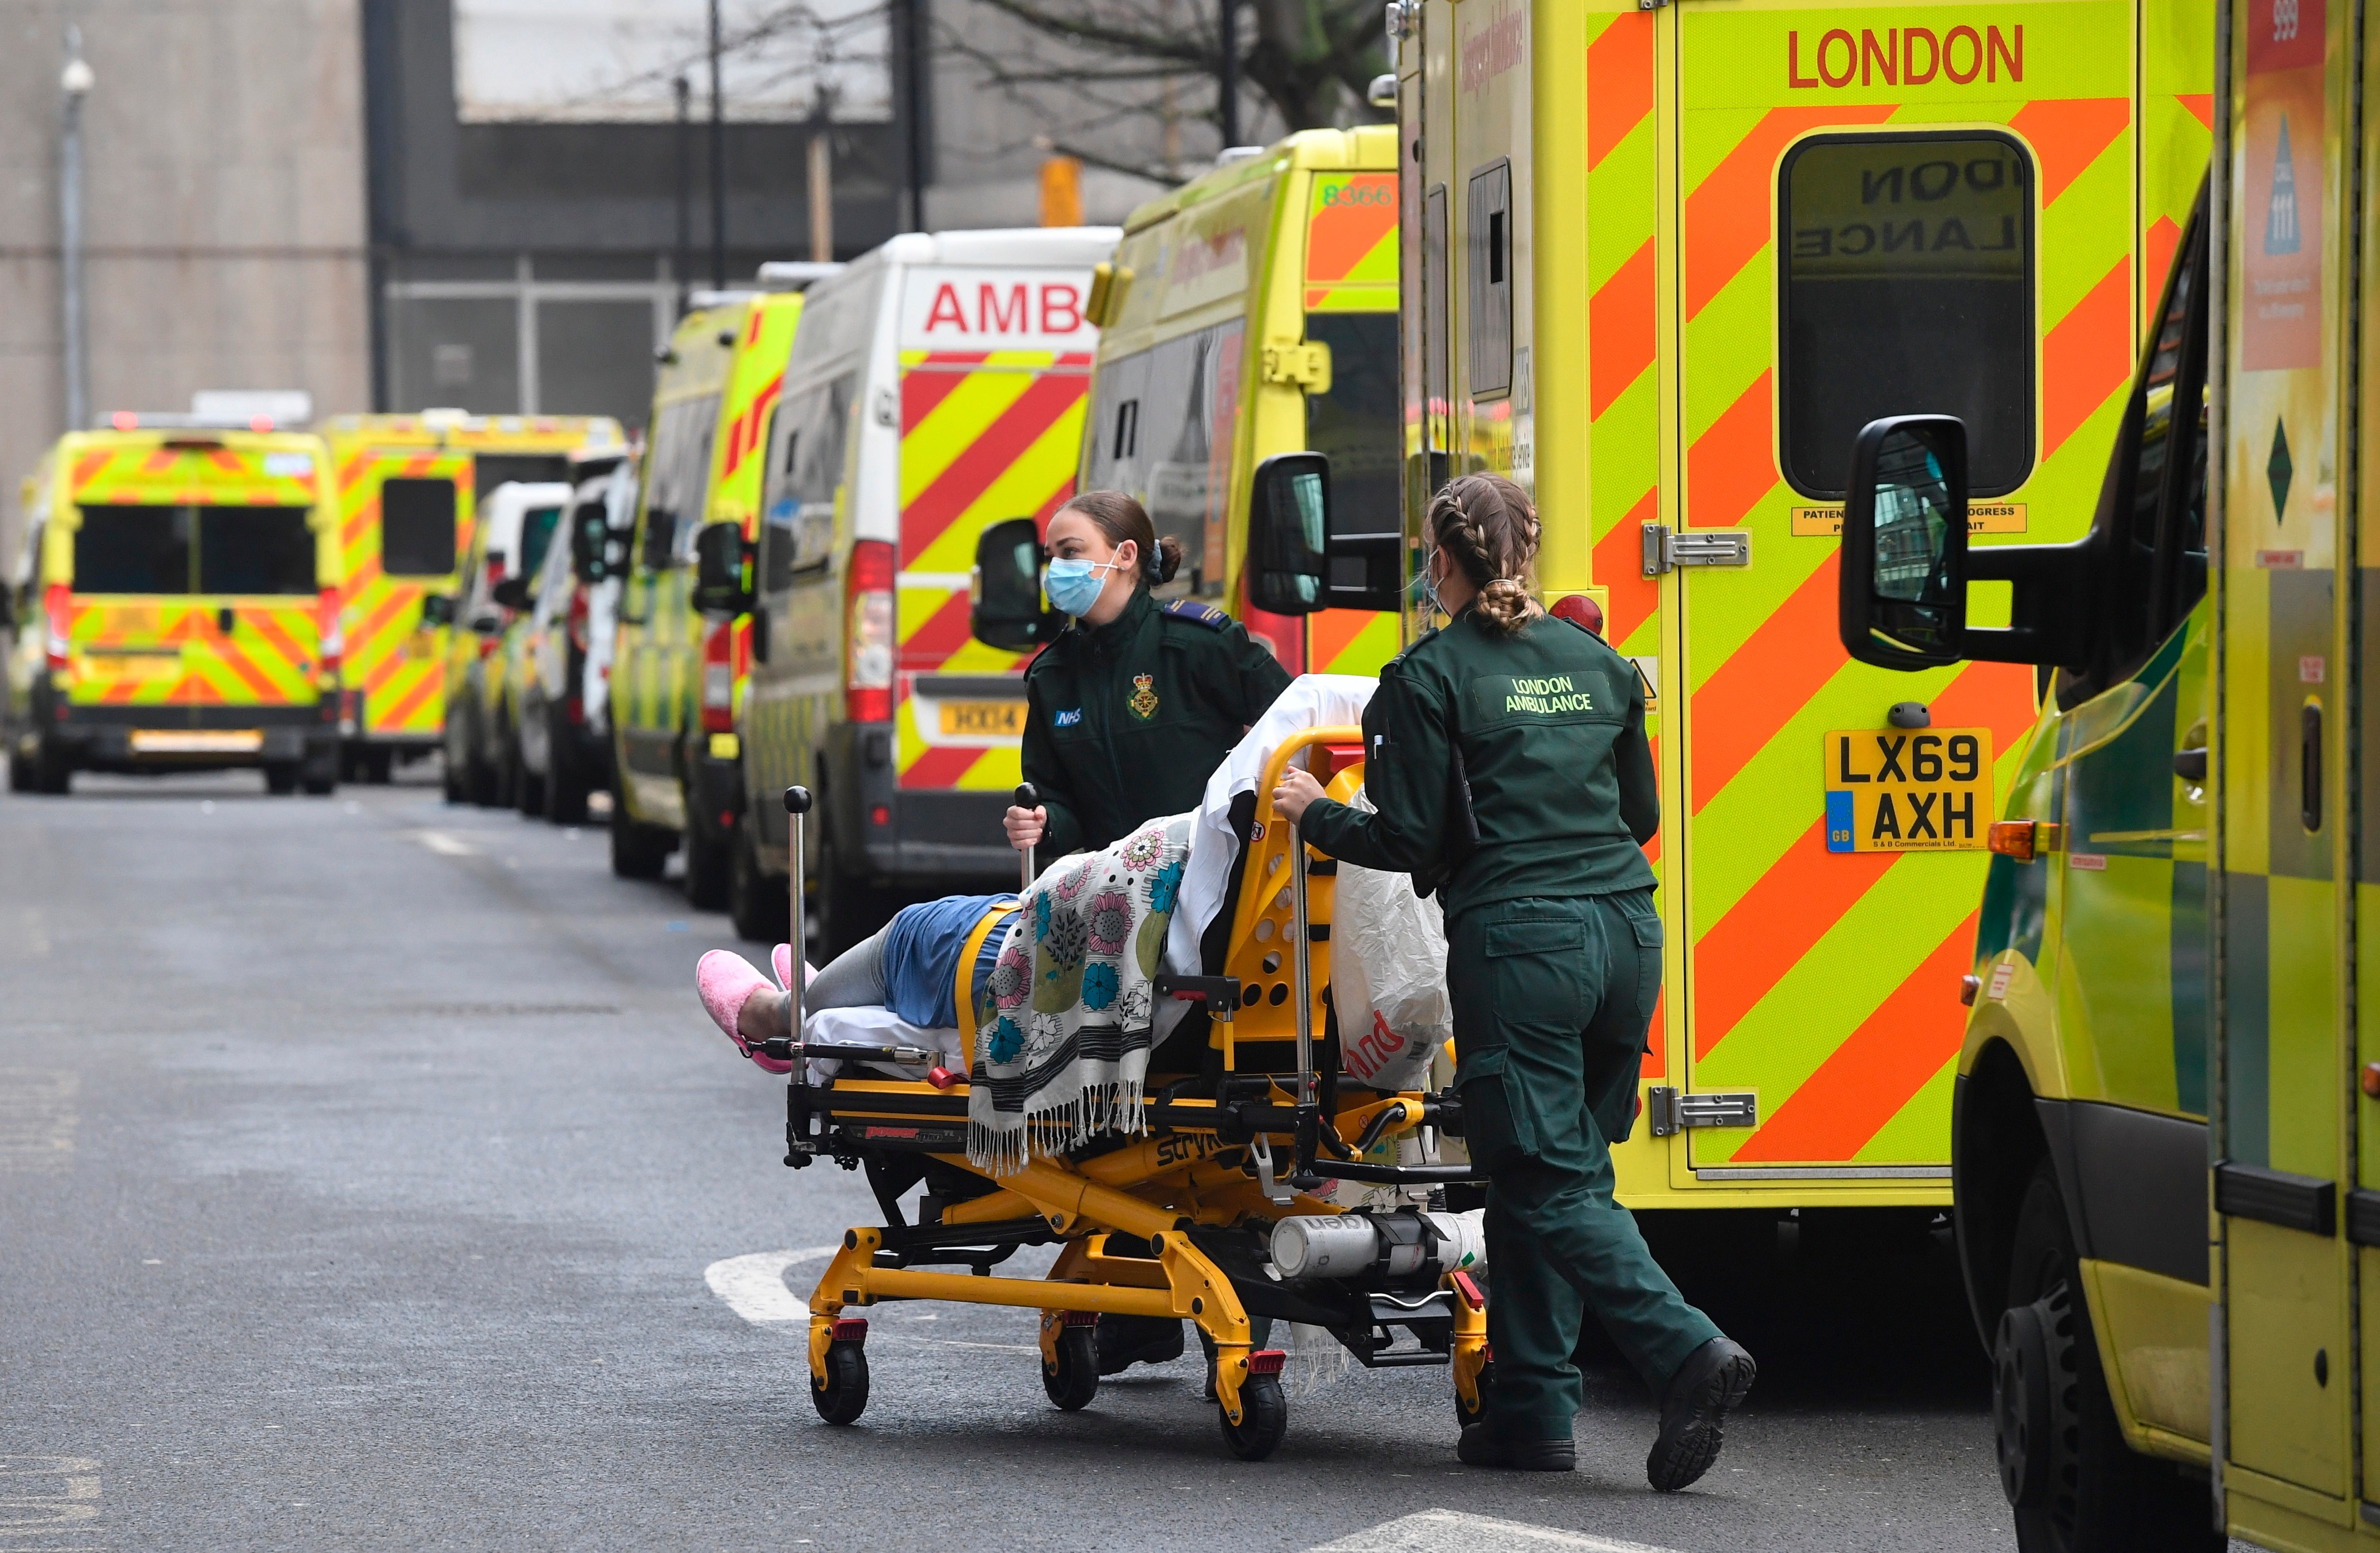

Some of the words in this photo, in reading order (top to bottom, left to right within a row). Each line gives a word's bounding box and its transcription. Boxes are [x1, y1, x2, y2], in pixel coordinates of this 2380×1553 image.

[1788, 25, 2023, 89] LONDON
[1324, 184, 1393, 207] 8366
[924, 281, 1081, 334] AMB
[1803, 510, 1844, 519] PATIEN
[1967, 507, 2015, 516] OGRESS
[1511, 676, 1574, 695] LONDON
[1506, 694, 1593, 713] AMBULANCE
[1057, 708, 1081, 724] NHS
[1840, 735, 1979, 783] LX69
[1872, 792, 1973, 840] AXH
[1832, 830, 1850, 842] GB
[1345, 1009, 1405, 1080] and
